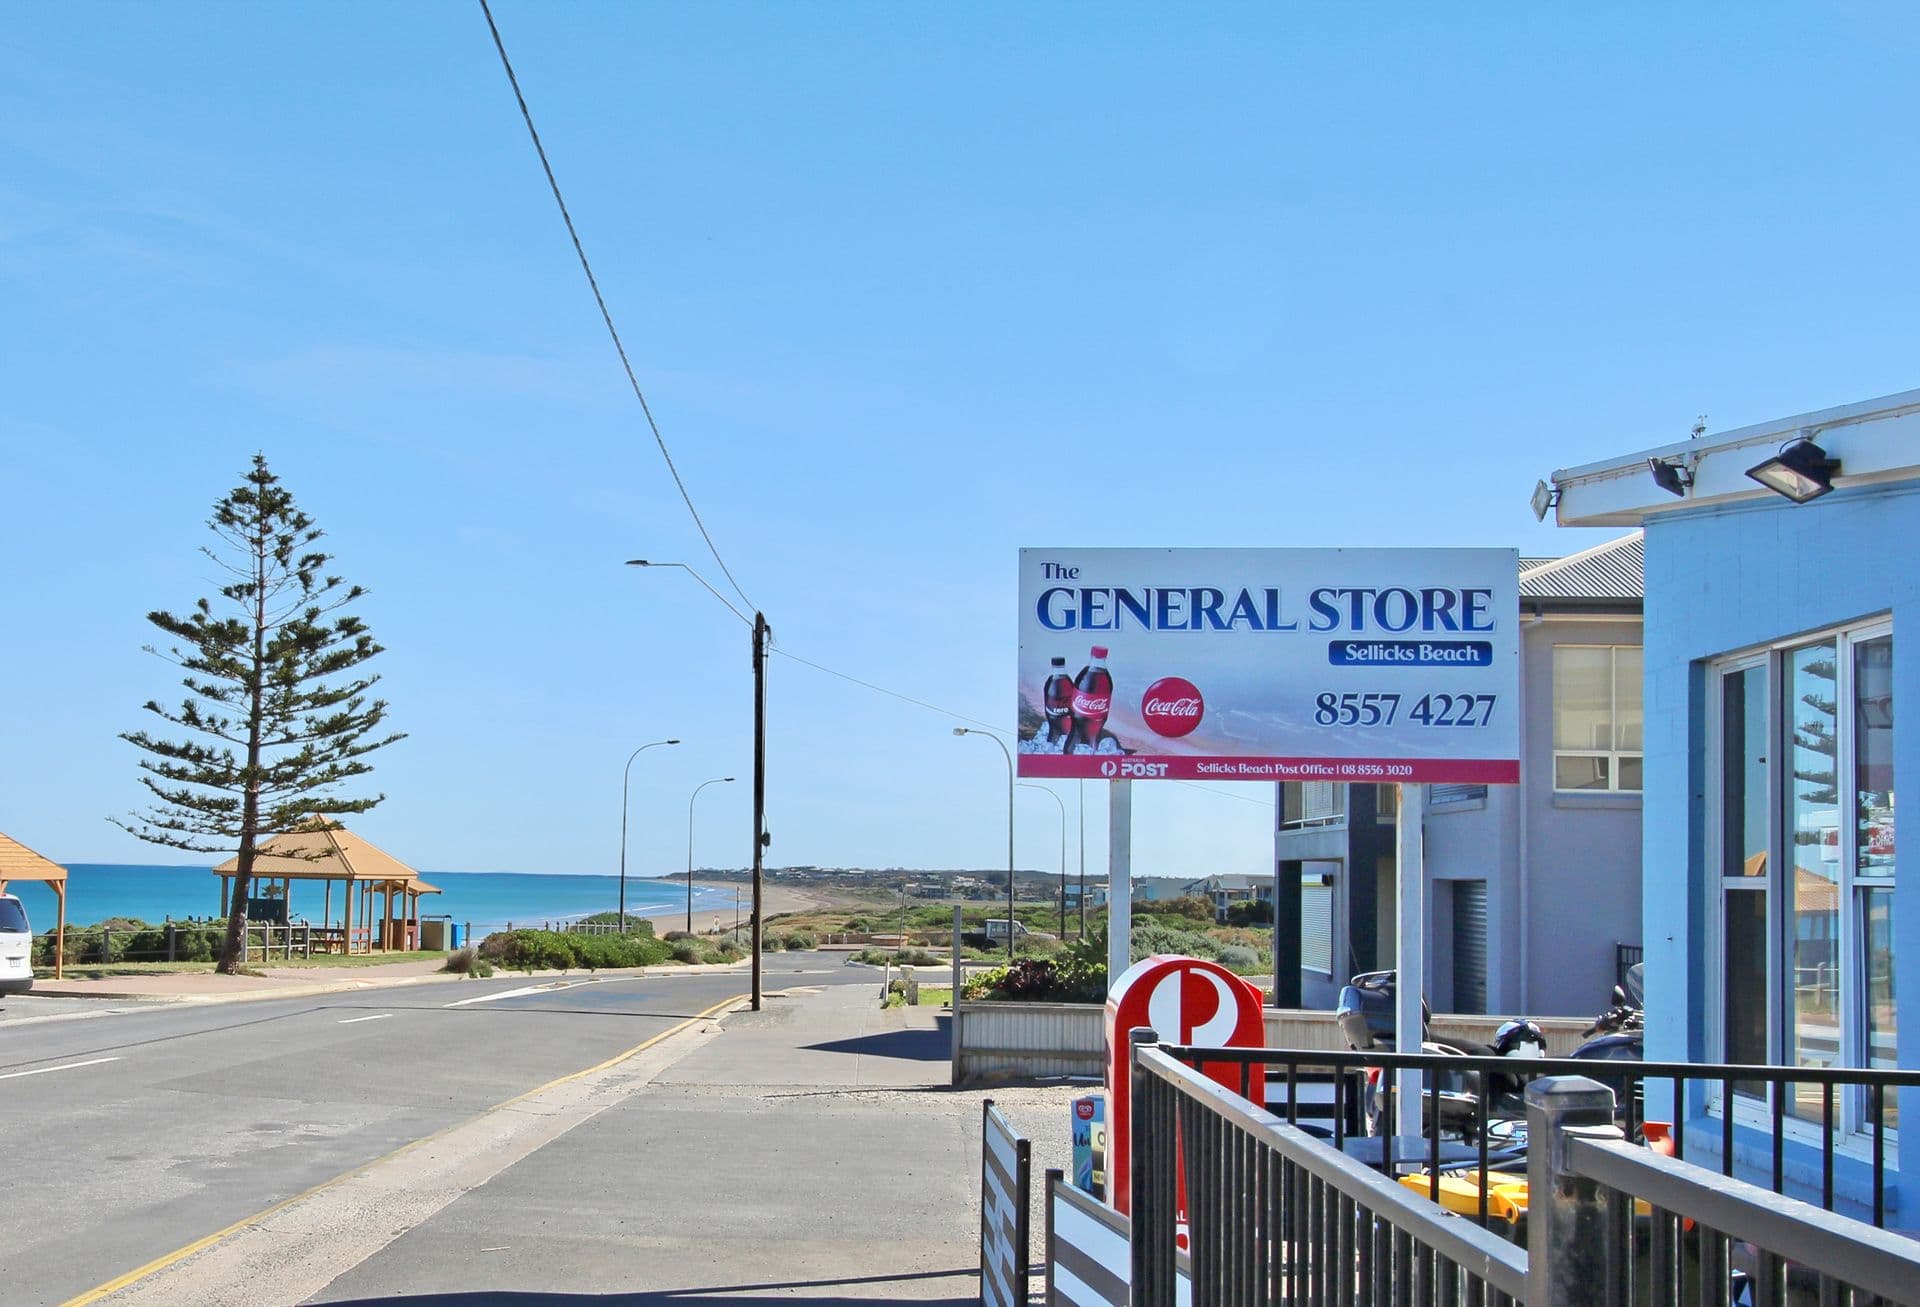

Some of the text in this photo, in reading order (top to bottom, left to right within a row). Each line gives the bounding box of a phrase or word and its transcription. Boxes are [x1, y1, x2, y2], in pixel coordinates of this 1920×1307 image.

[1040, 562, 1080, 580] The
[1036, 586, 1496, 632] GENERAL STORE
[1345, 644, 1480, 661] Sellicks Beach
[1145, 697, 1201, 717] Coca-Cola
[1314, 692, 1497, 727] 8557 4227
[1120, 763, 1169, 777] POST
[1196, 762, 1237, 774] Sellicks
[1238, 763, 1273, 774] Beach
[1274, 763, 1299, 775] Post
[1299, 763, 1334, 775] Office
[1341, 764, 1357, 776] 08
[1357, 764, 1384, 776] 8556
[1386, 765, 1413, 776] 3020
